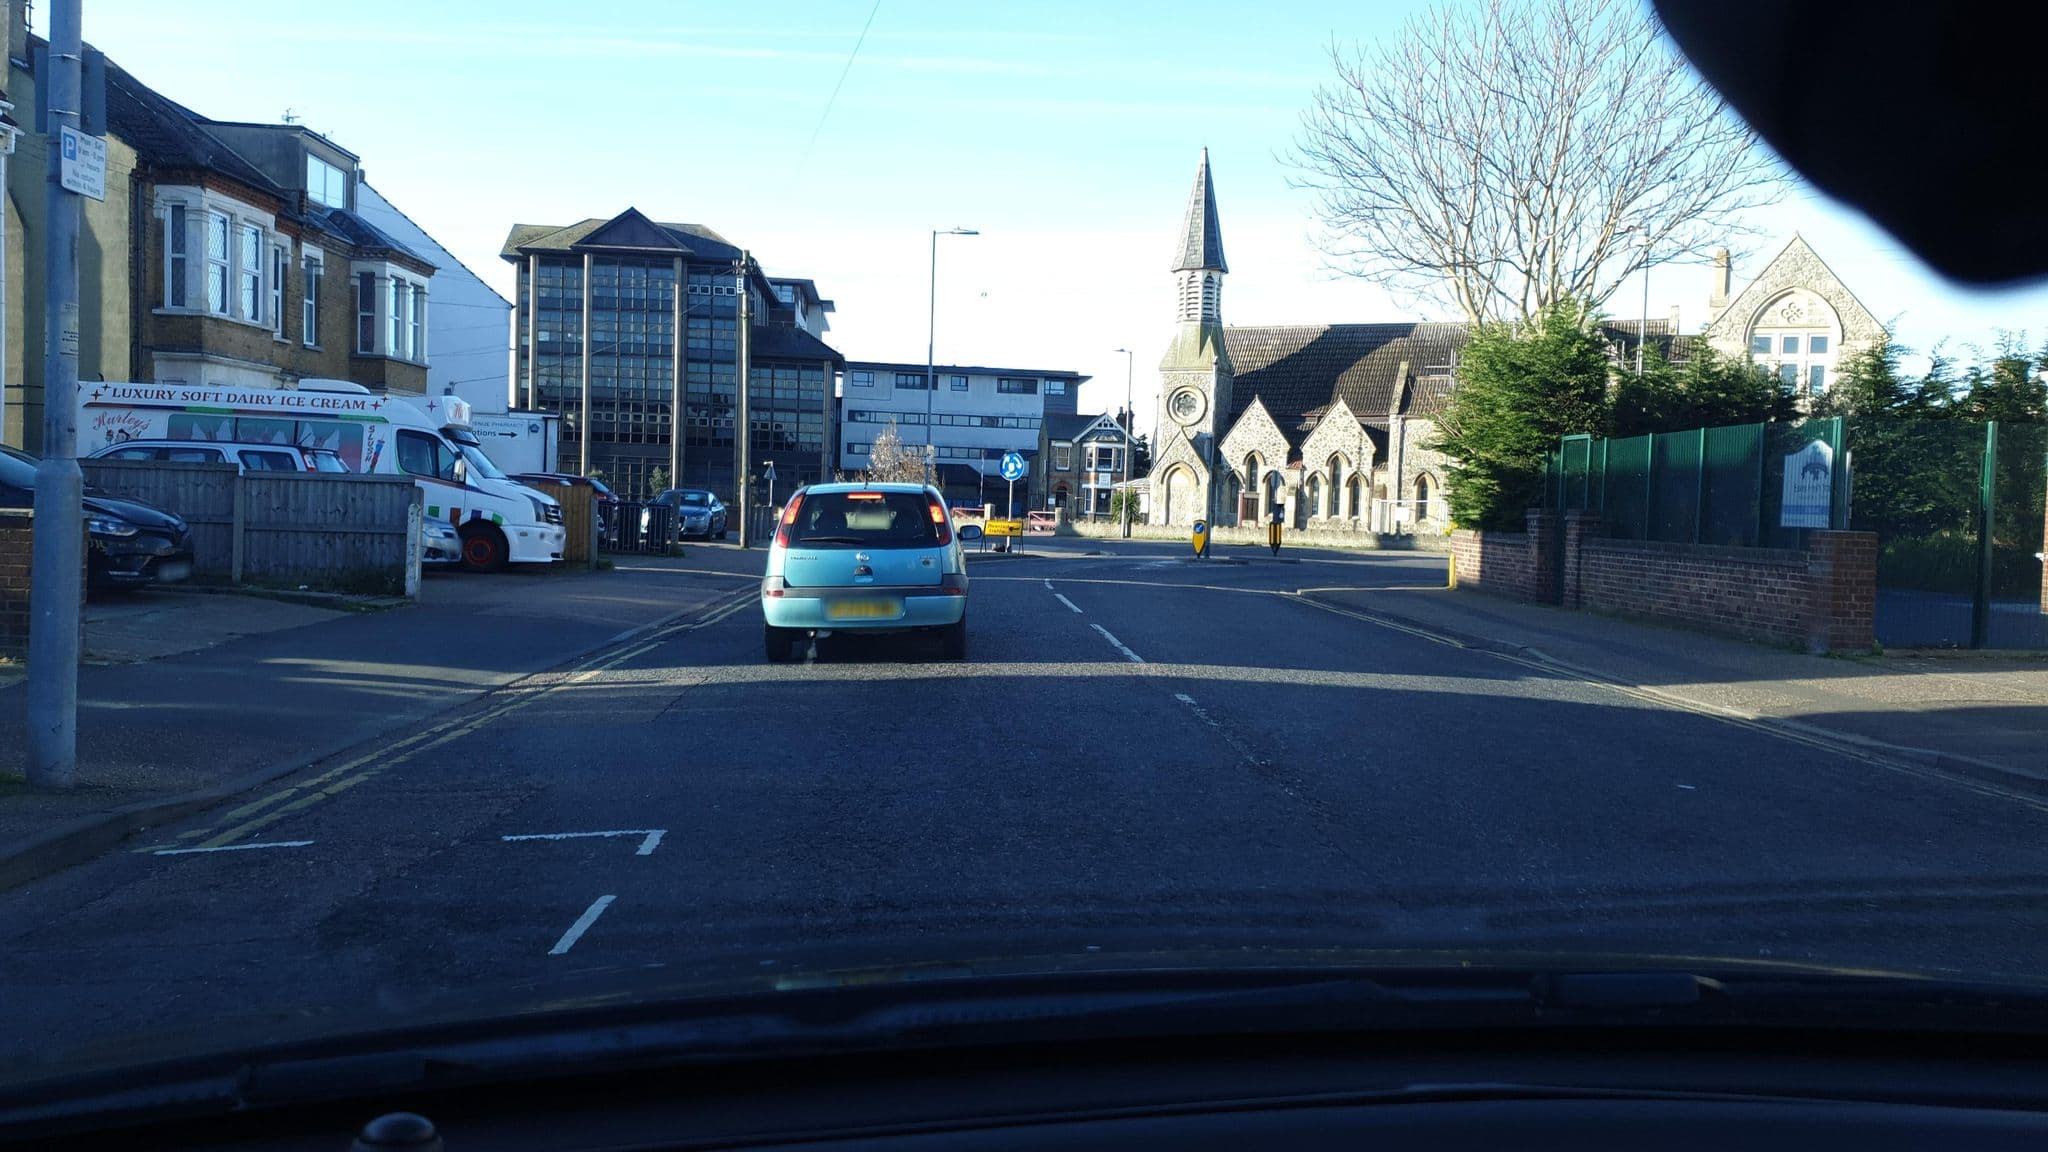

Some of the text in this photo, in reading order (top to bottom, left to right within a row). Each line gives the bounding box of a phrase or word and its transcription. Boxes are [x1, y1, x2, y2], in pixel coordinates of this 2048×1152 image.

[111, 387, 366, 410] LUXURY SOFT DAIRY ICE CREAM
[364, 425, 375, 462] SLUSH
